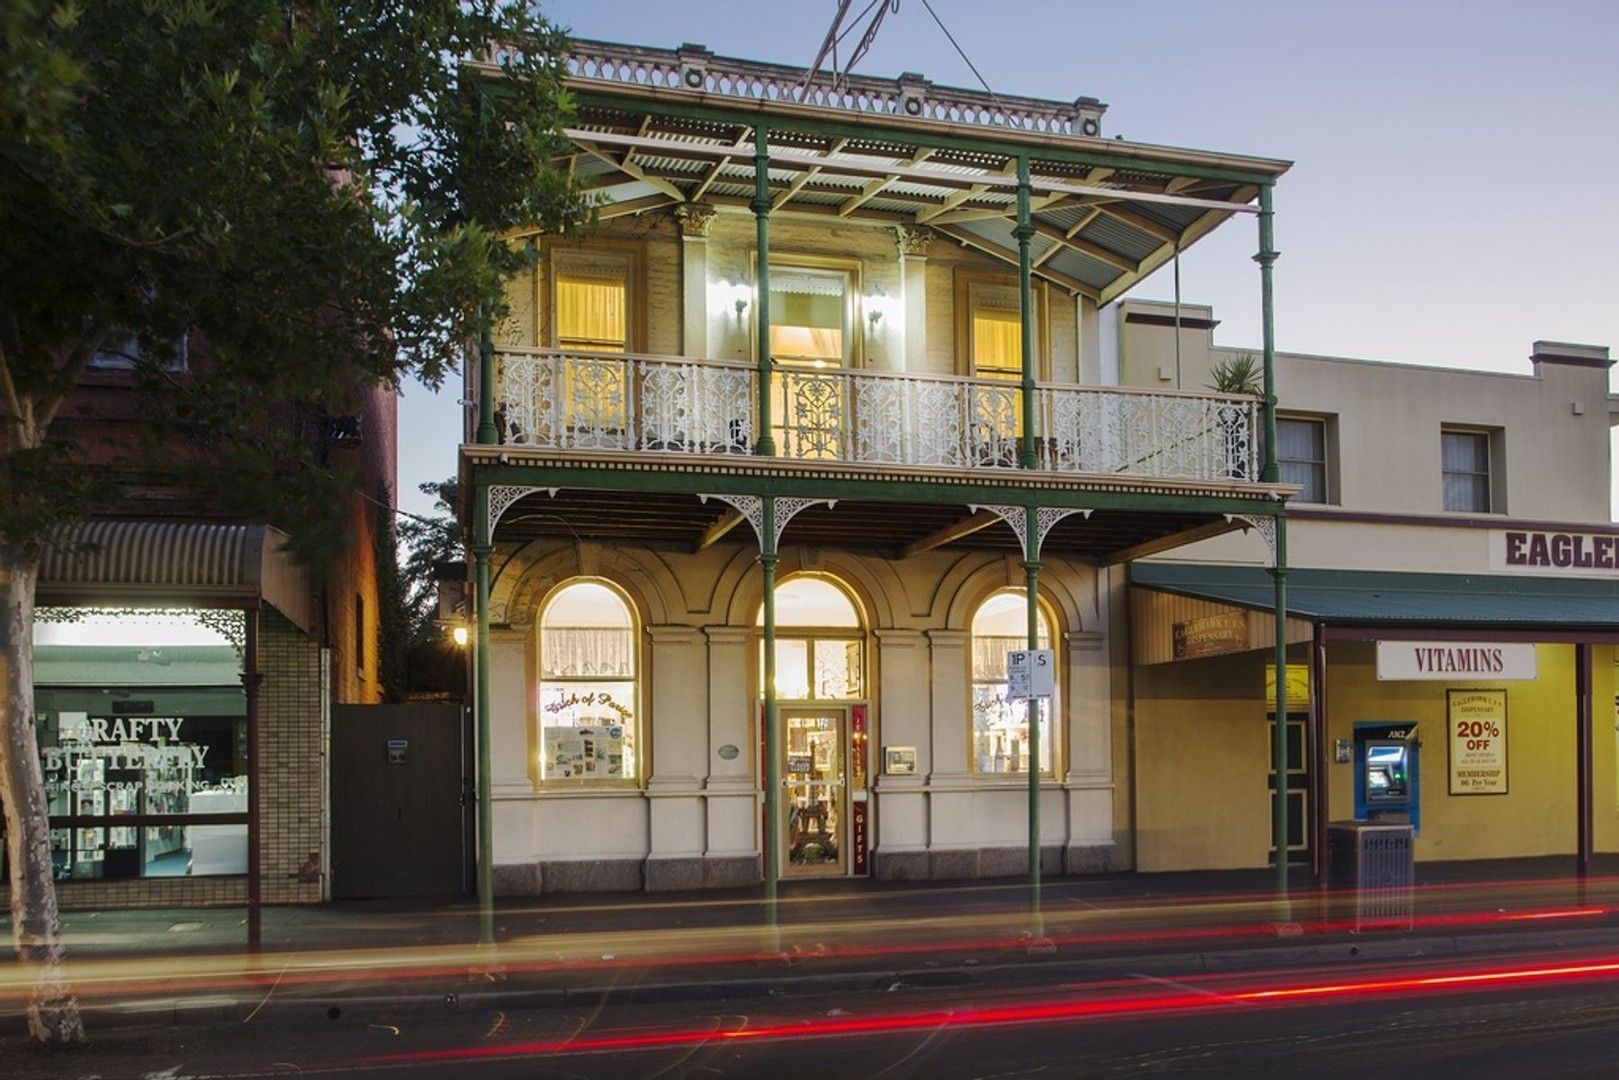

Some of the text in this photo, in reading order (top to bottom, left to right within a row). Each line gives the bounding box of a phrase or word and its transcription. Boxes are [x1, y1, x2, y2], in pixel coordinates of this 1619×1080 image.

[1506, 532, 1619, 569] EAGLE
[1038, 654, 1047, 667] S
[1414, 648, 1503, 673] VITAMINS
[581, 692, 595, 706] of
[74, 718, 184, 741] CRAFTY
[1457, 720, 1500, 738] 20%
[1466, 739, 1490, 751] OFF
[44, 745, 209, 771] BUTTERFLY
[1457, 770, 1501, 778] MEMBERSHIP
[855, 815, 864, 864] GIFTS
